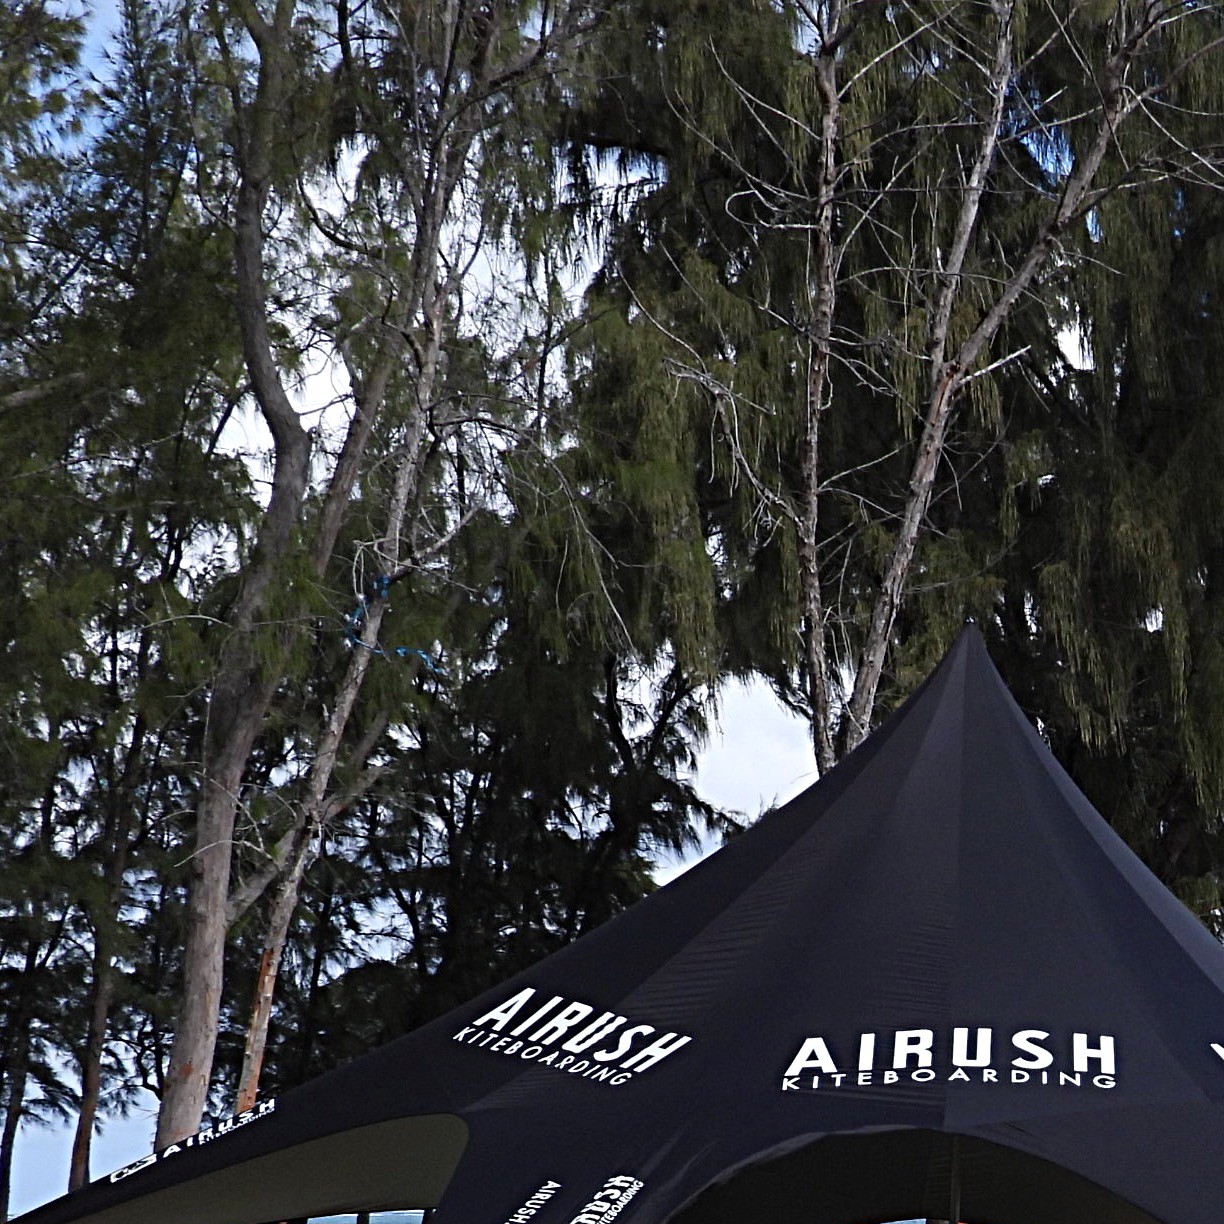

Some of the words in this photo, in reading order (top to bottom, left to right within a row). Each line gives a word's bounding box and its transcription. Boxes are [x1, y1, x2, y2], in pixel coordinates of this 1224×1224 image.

[452, 1026, 633, 1086] KITEBOARDING
[472, 987, 693, 1073] AIRUSH
[783, 1026, 1117, 1077] AIRUSH
[781, 1067, 1117, 1091] KITEBOARDING
[163, 1098, 276, 1158] AIRUSH
